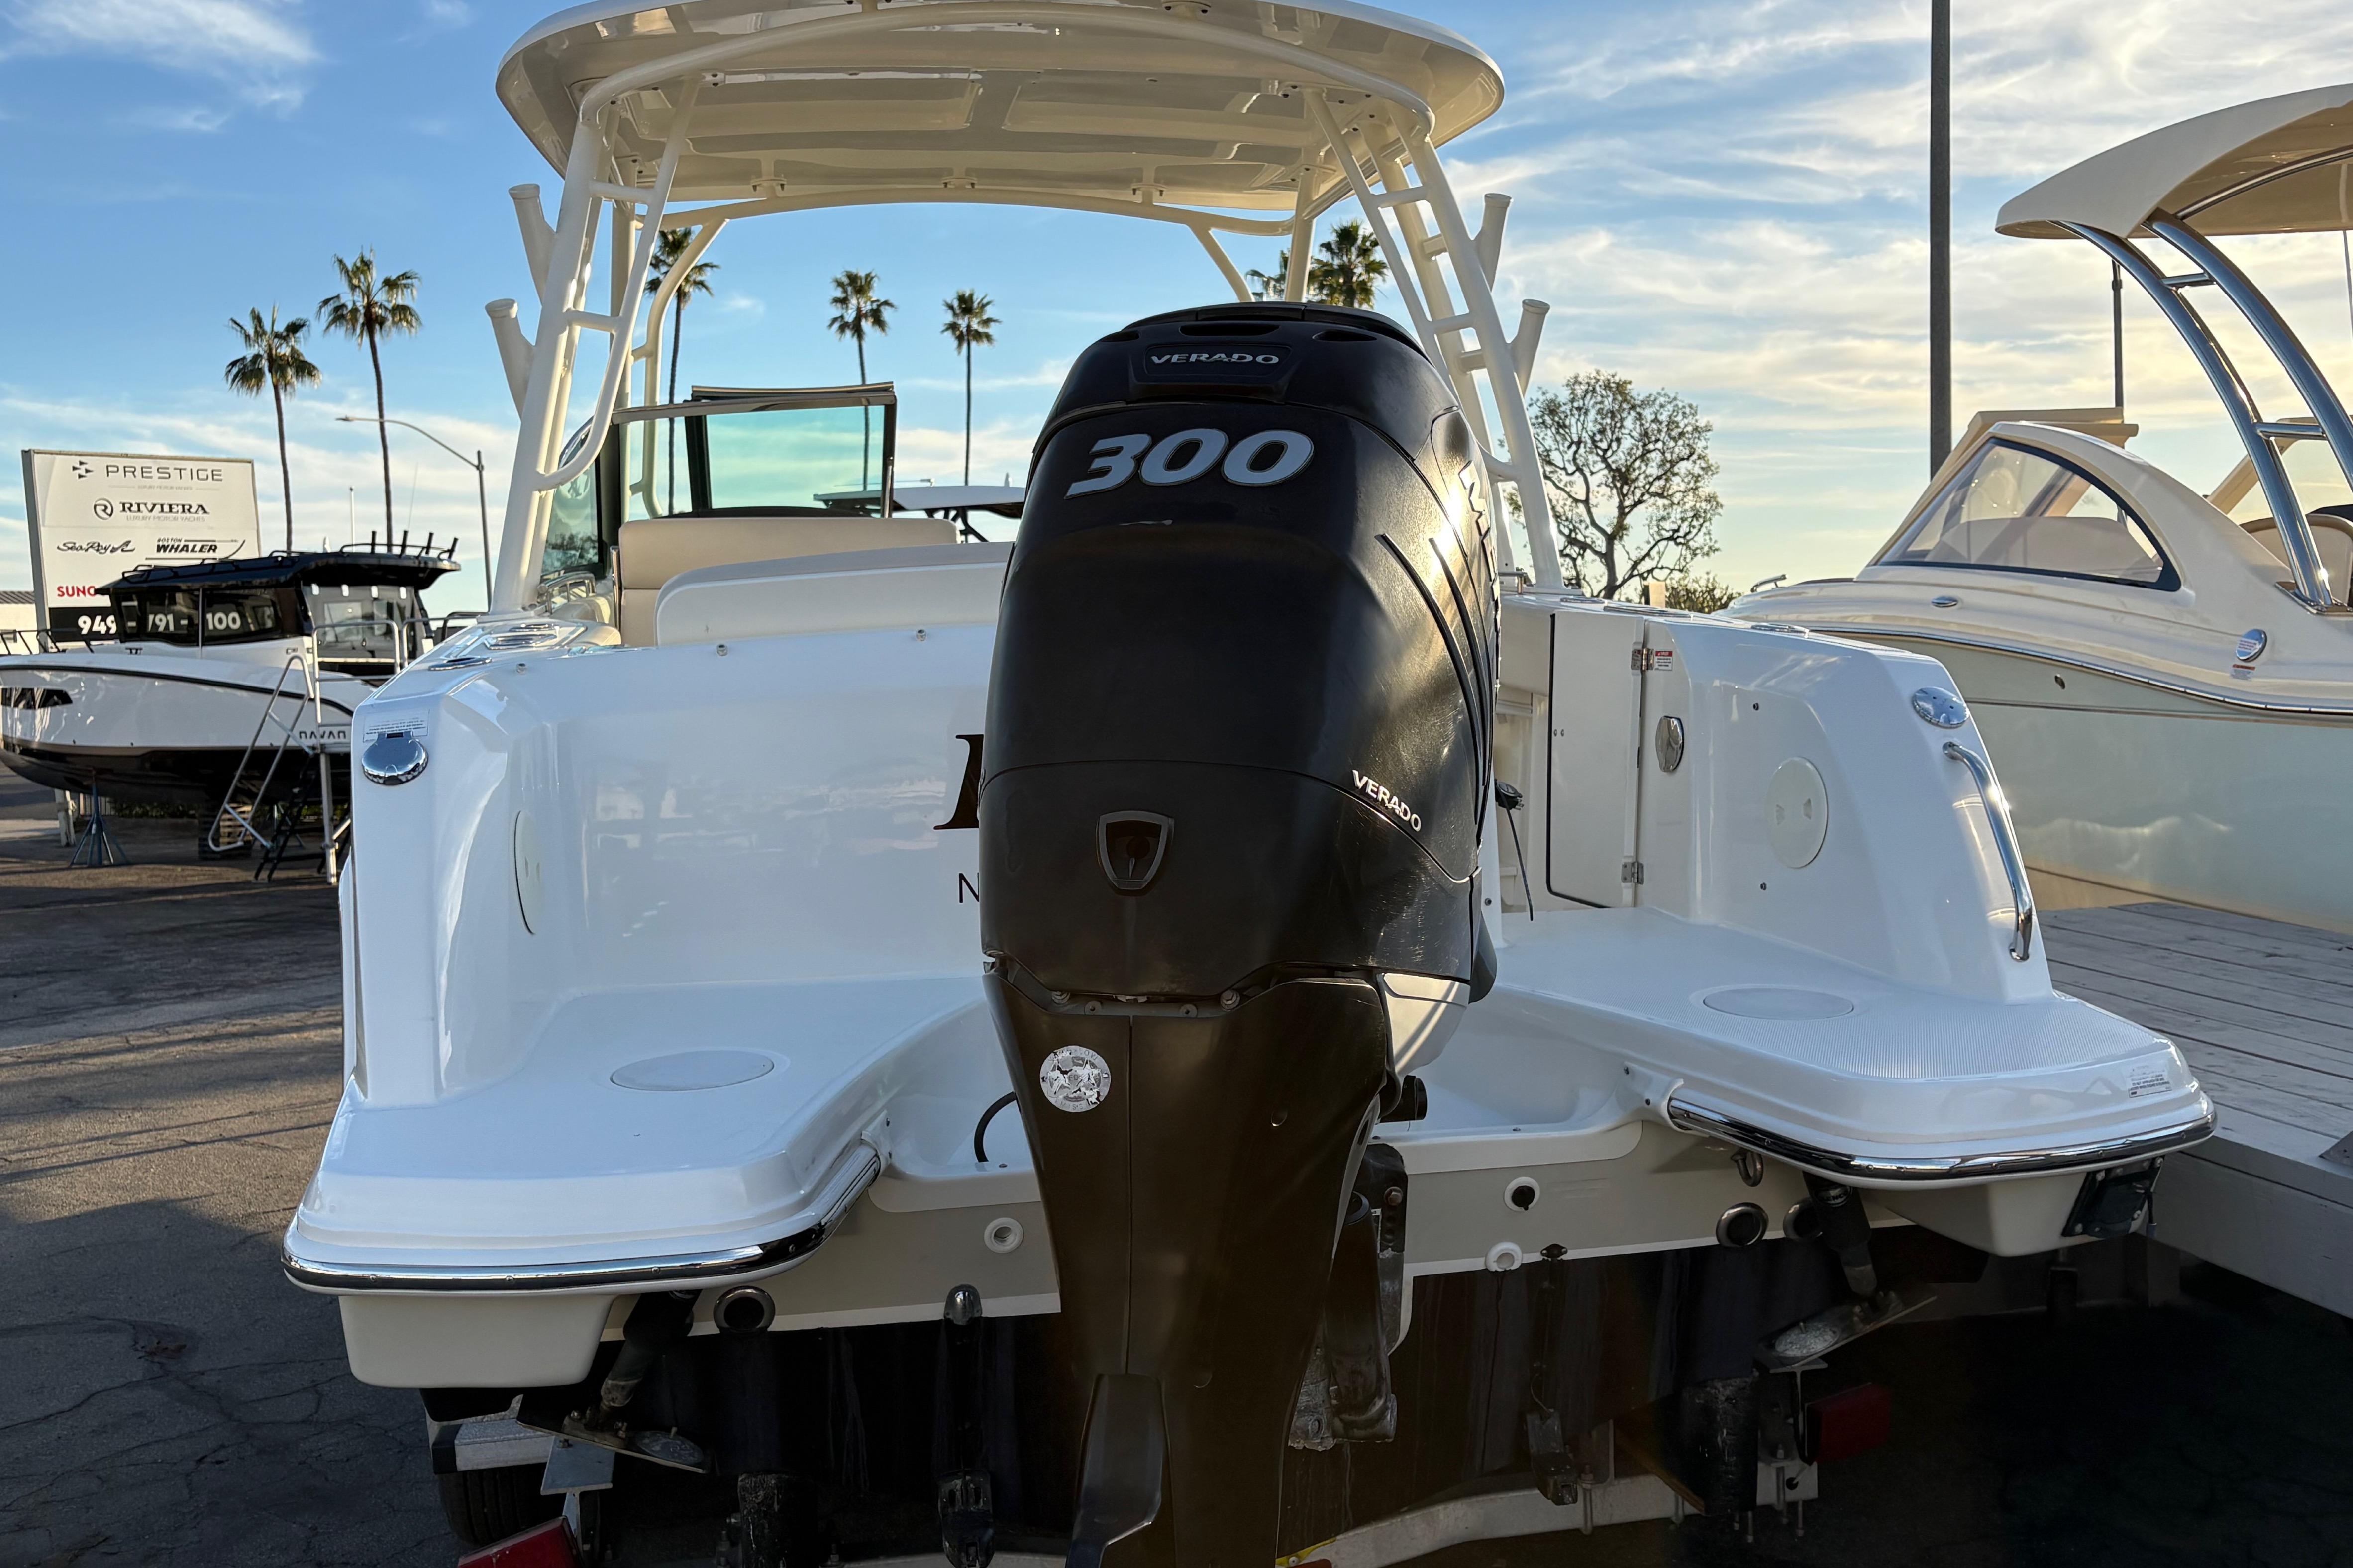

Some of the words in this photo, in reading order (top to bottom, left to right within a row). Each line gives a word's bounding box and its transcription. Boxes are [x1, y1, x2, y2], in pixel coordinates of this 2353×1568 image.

[1150, 353, 1279, 364] VERADO
[1064, 428, 1314, 499] 300
[106, 464, 223, 482] PRESTIGE
[119, 501, 210, 515] RIVIERA
[156, 544, 217, 553] WHALER
[78, 614, 117, 634] 949
[1352, 769, 1422, 832] VERADO
